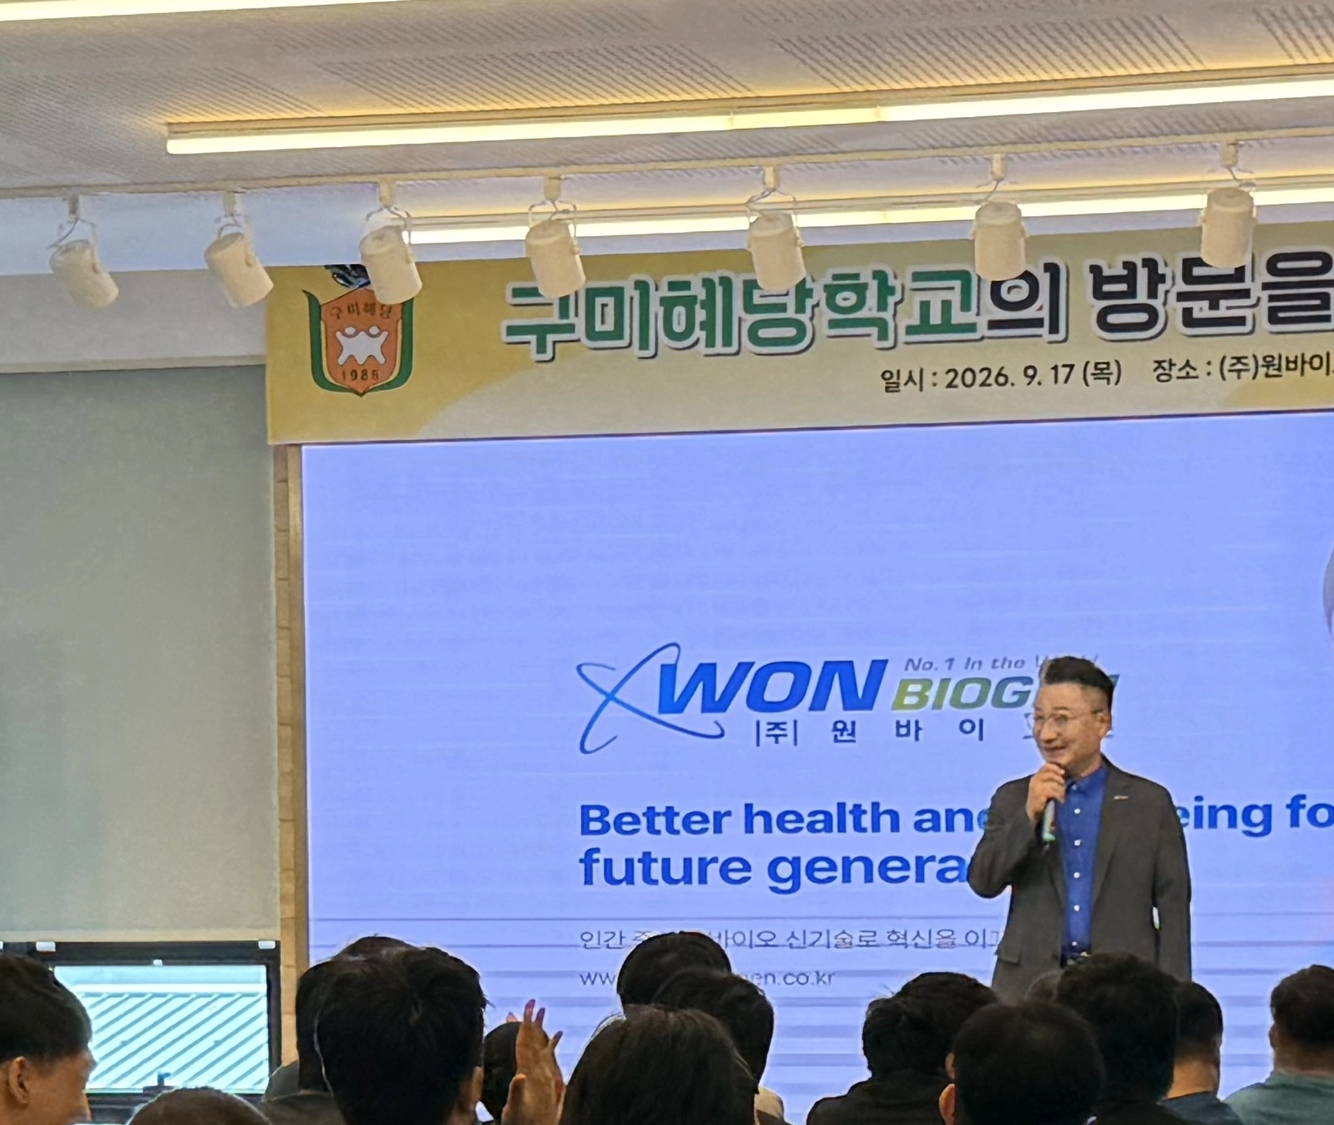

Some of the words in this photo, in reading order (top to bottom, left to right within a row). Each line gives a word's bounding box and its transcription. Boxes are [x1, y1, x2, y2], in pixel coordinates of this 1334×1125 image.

[504, 262, 1063, 357] 구미혜당학교의
[880, 368, 924, 393] 일시
[944, 366, 1015, 389] 2026.
[1022, 364, 1042, 387] 9.
[1050, 363, 1075, 385] 17
[1082, 359, 1122, 387] (목)
[1153, 358, 1199, 383] 장소
[991, 655, 1027, 670] the
[658, 659, 889, 714] WON
[890, 672, 1120, 712] BIOG
[580, 804, 732, 836] Better
[744, 801, 901, 835] health
[578, 847, 753, 886] future
[767, 853, 969, 896] genera
[580, 929, 625, 950] 인간
[786, 929, 878, 950] 신기술로
[886, 928, 956, 950] 혁신을
